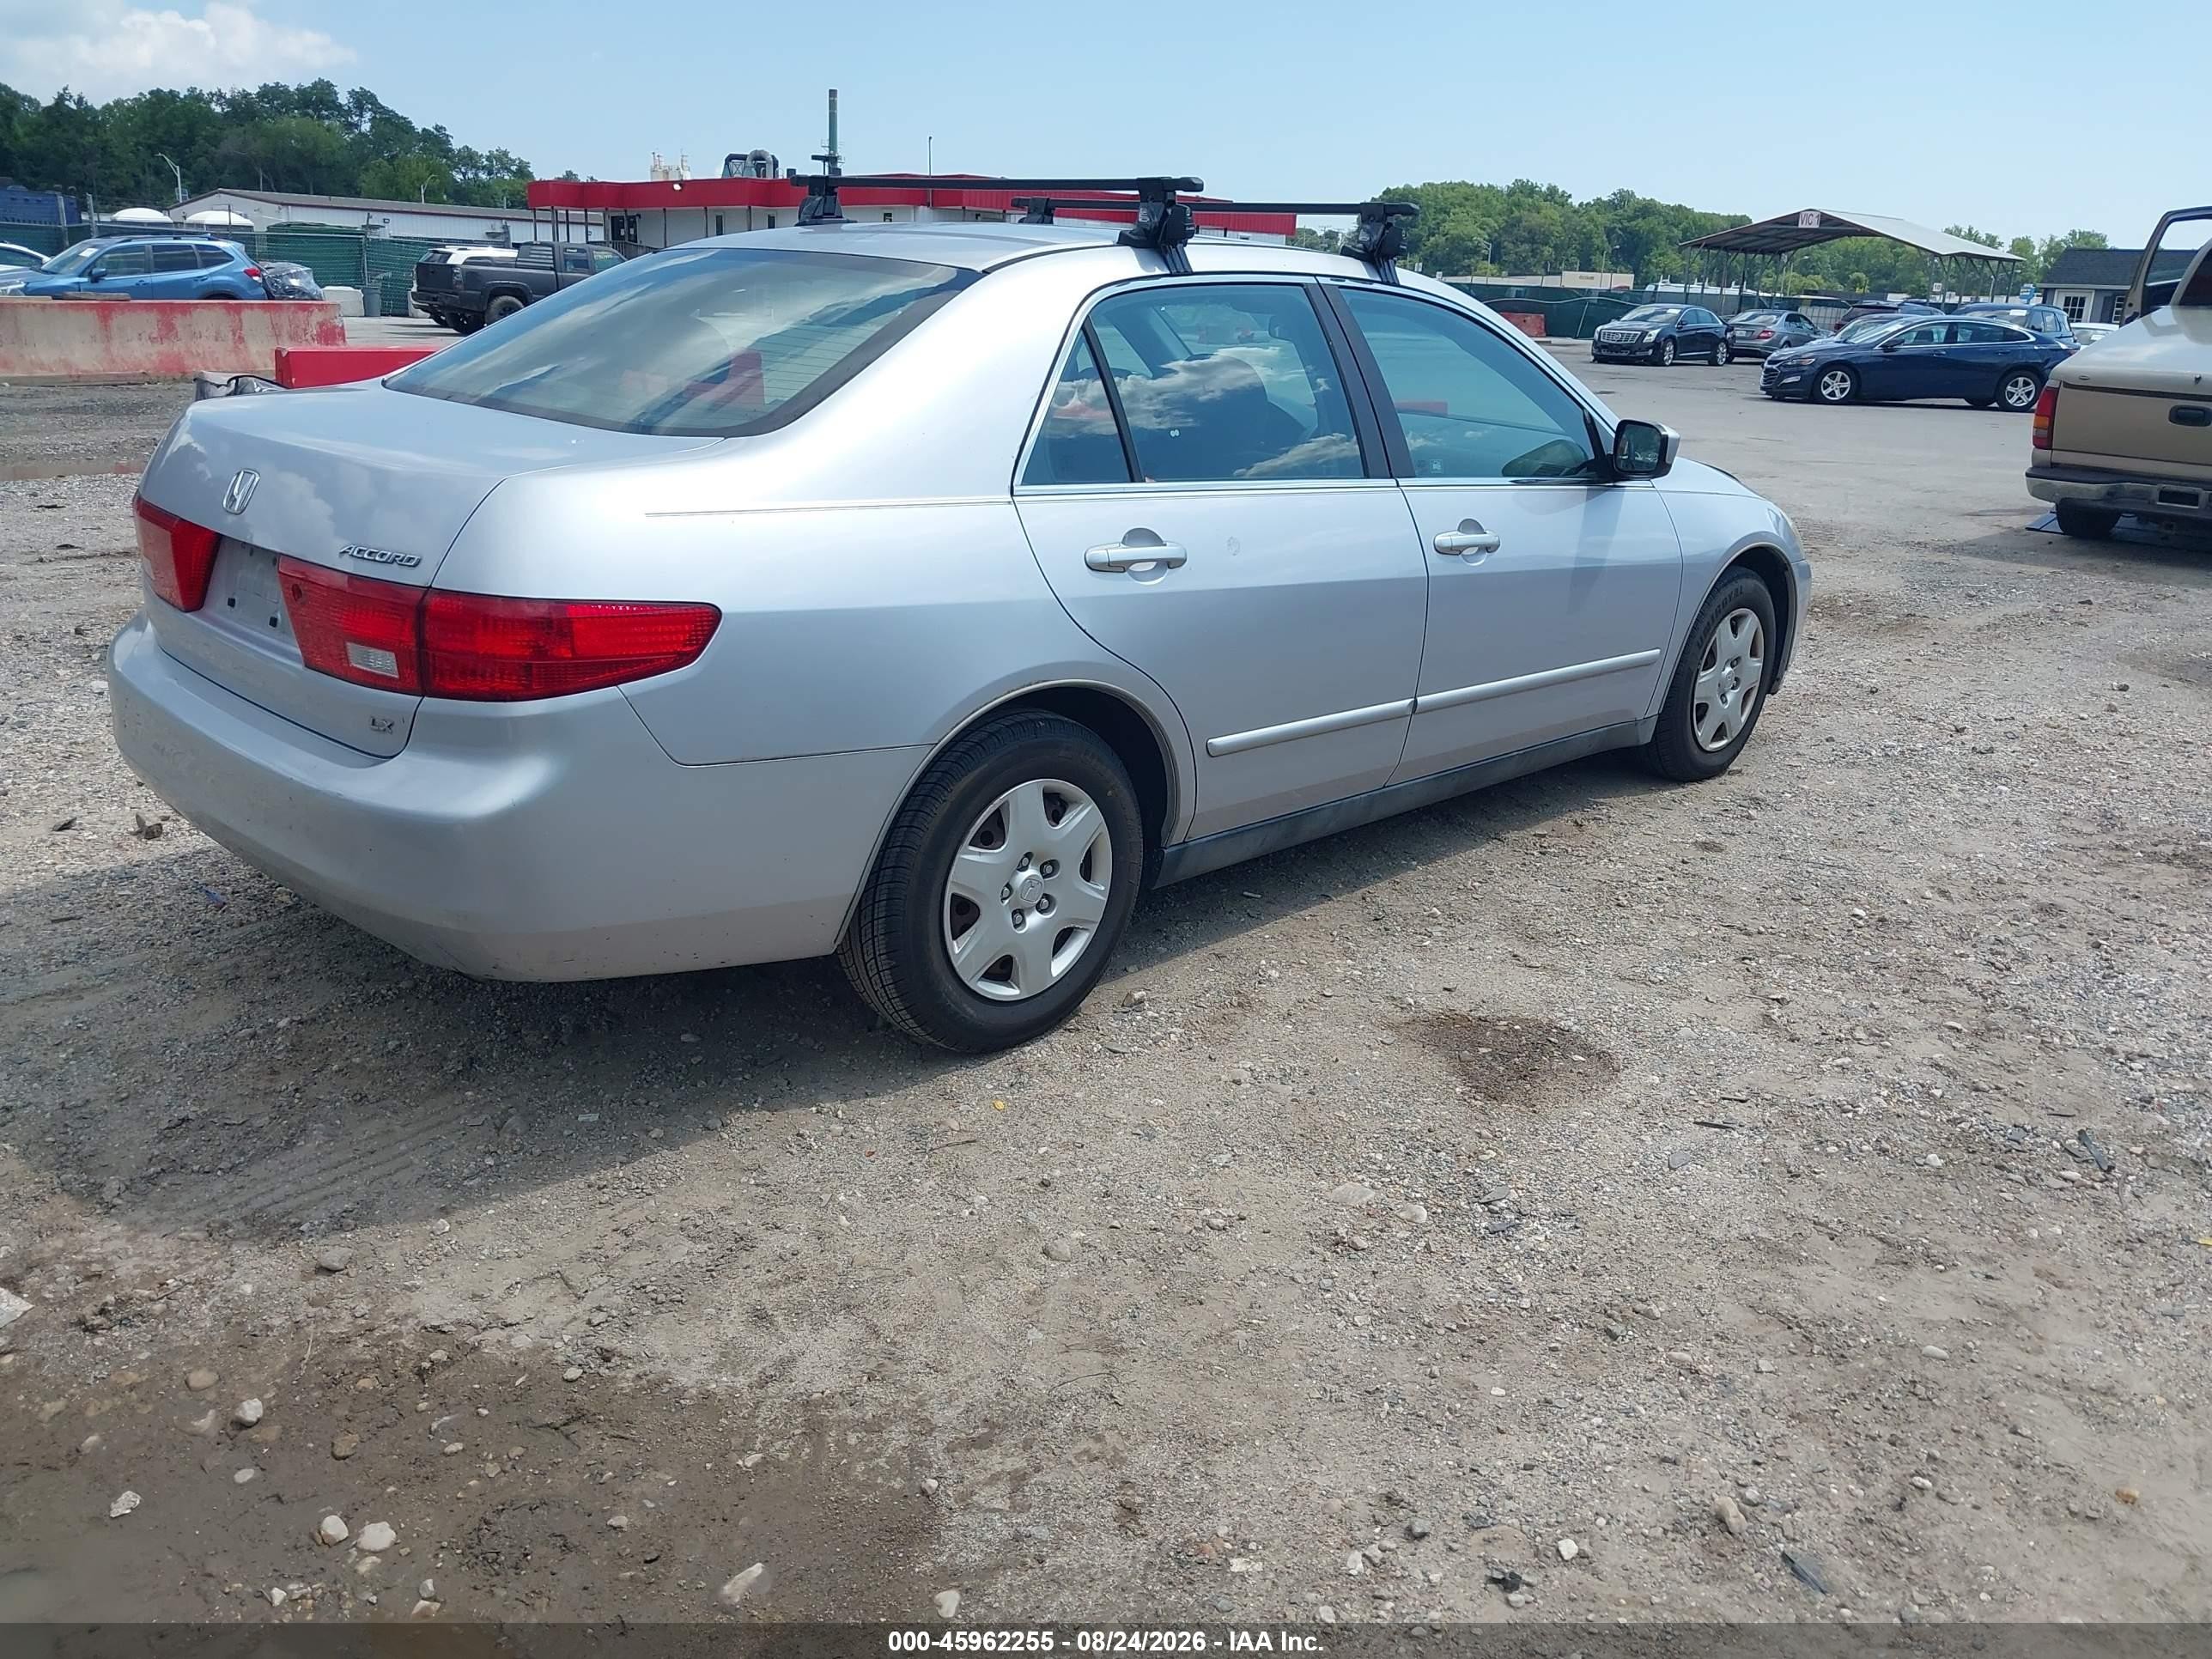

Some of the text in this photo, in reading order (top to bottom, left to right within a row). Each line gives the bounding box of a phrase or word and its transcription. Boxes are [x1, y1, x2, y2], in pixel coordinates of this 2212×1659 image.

[1800, 212, 1820, 226] VIC 1
[338, 544, 422, 568] ACCORD
[371, 717, 394, 735] LX
